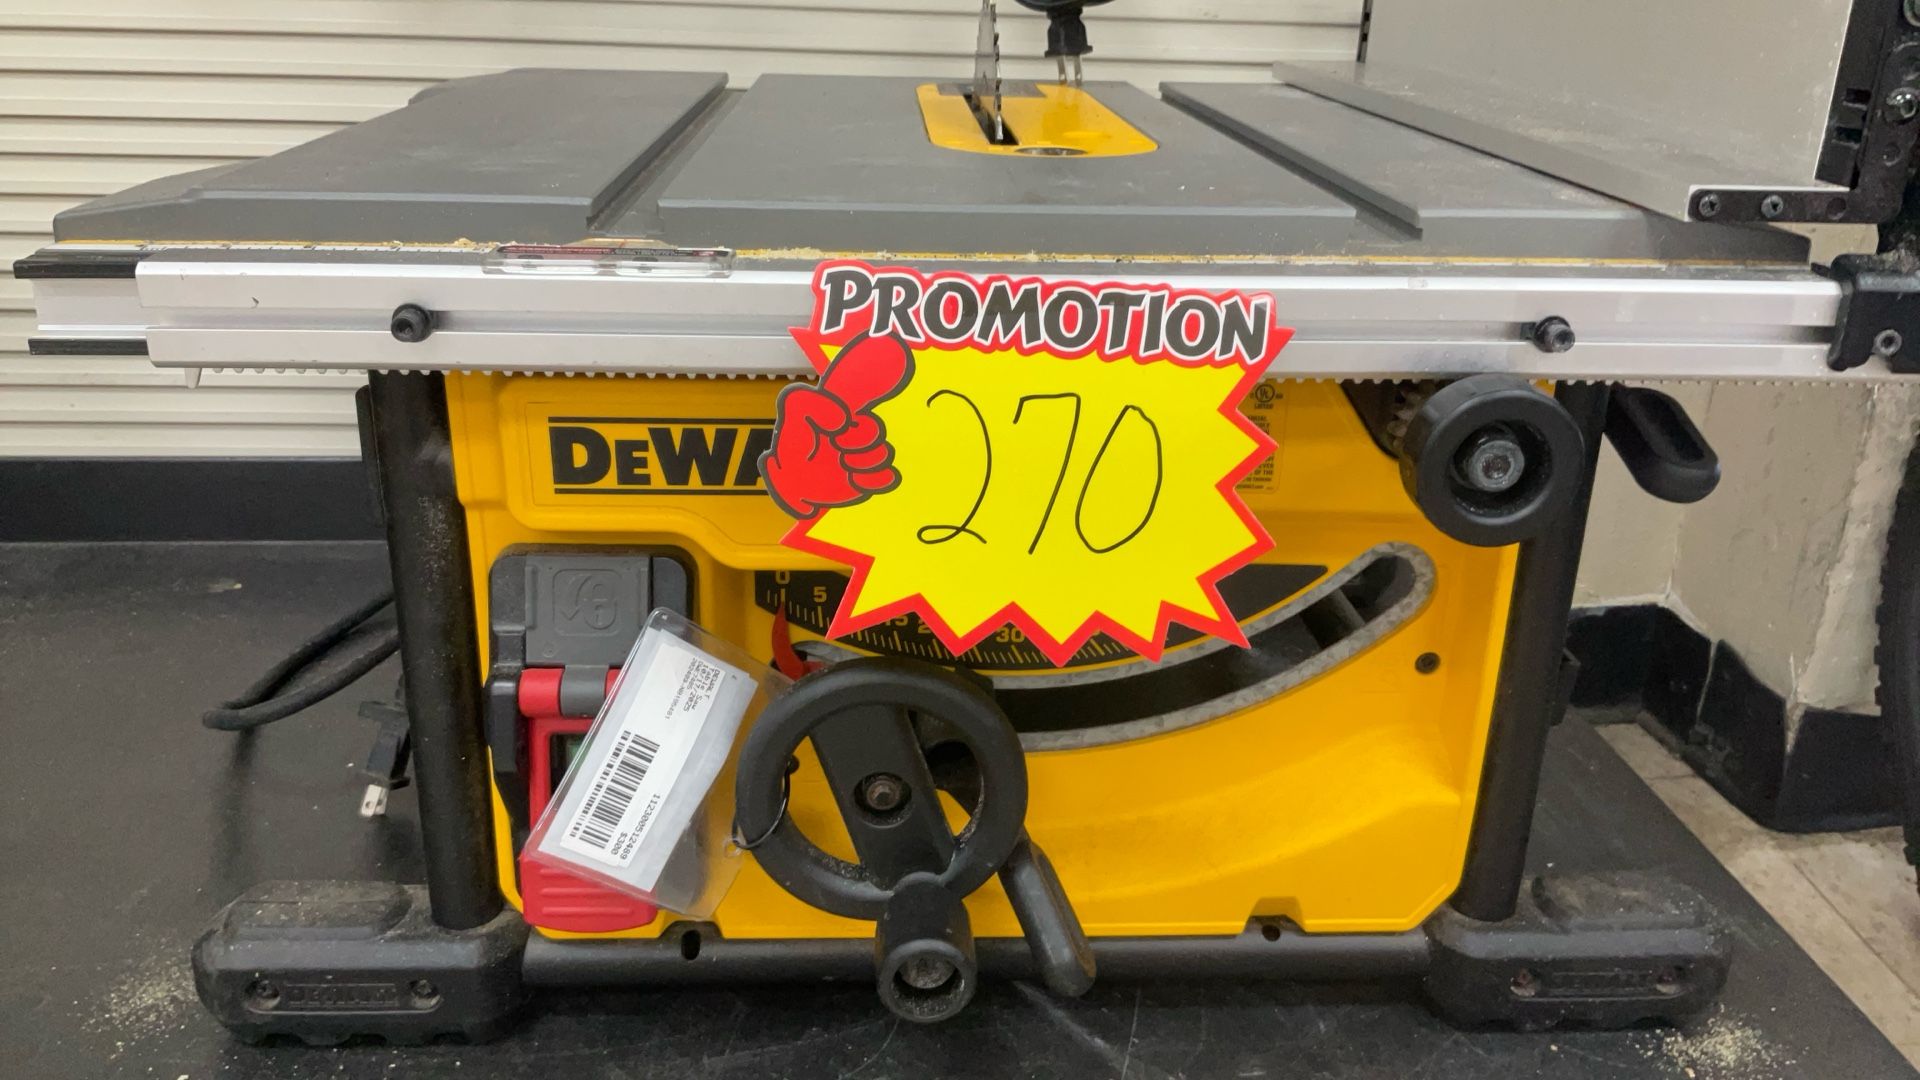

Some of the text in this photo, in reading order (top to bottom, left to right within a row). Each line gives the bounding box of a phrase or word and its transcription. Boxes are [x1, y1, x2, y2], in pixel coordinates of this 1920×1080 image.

[822, 267, 1271, 363] PROMOTION
[549, 426, 774, 486] DEWA
[916, 389, 1163, 555] 270
[775, 570, 791, 585] 0
[813, 586, 827, 603] 5
[996, 626, 1025, 643] 30
[683, 664, 709, 712] 10/17/2025
[691, 667, 715, 711] Table Saw
[610, 832, 628, 855] $300
[619, 794, 661, 860] 112300512489
